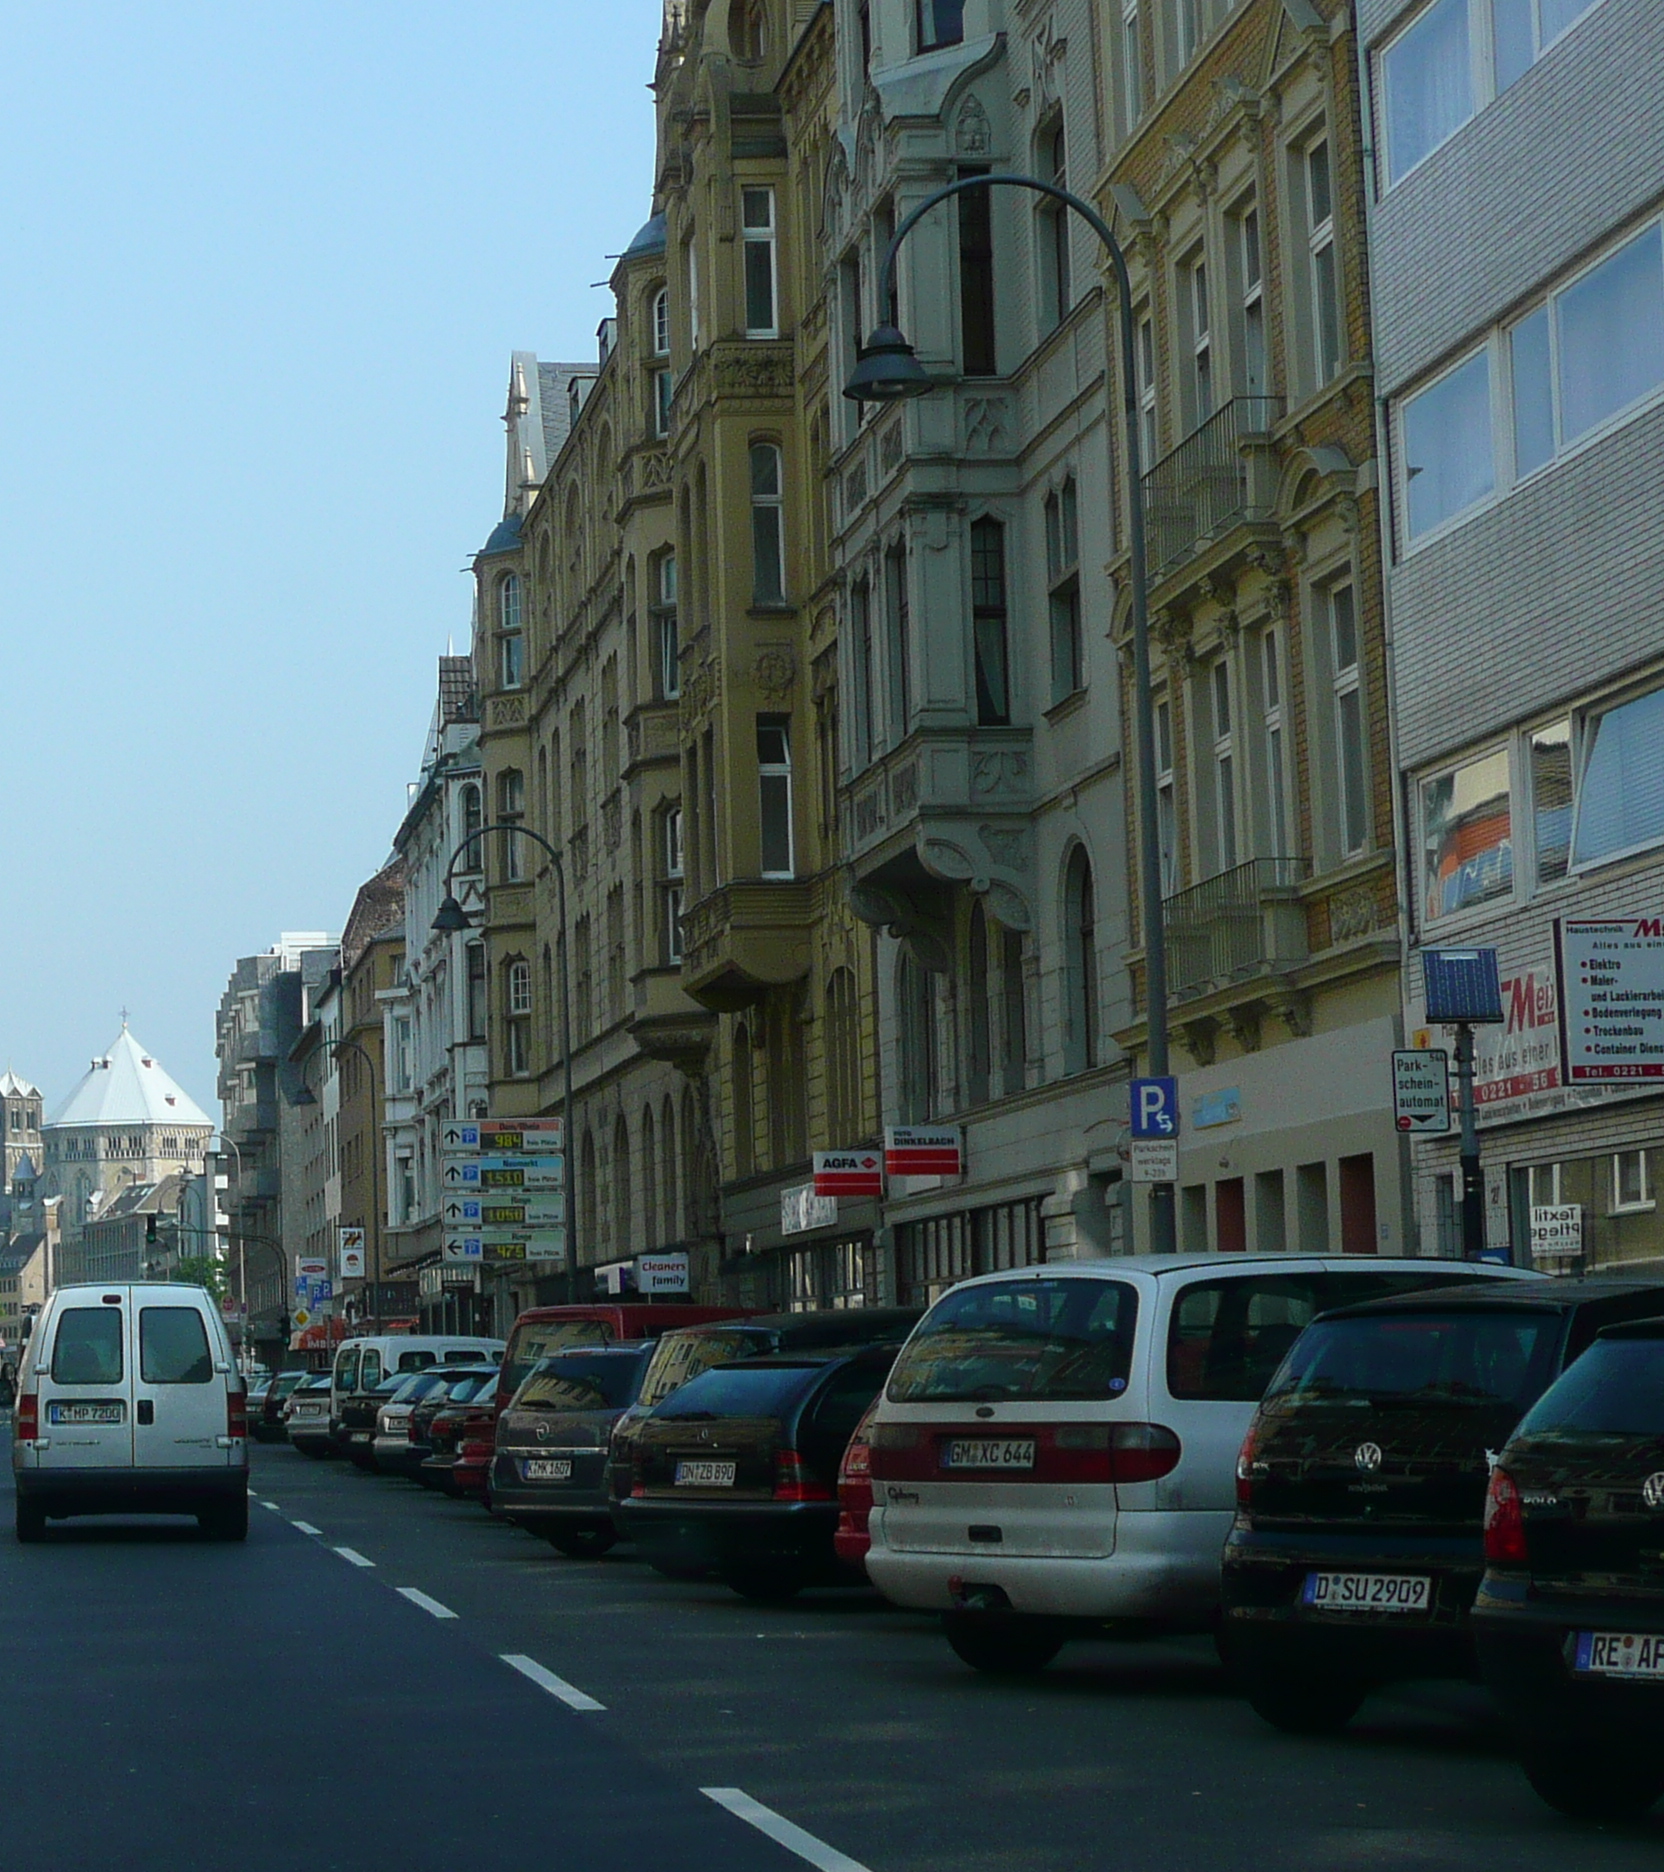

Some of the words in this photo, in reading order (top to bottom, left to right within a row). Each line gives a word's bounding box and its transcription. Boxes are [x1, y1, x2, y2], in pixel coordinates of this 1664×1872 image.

[1566, 925, 1624, 934] Haustechnik
[1592, 941, 1619, 950] Alles
[1589, 958, 1621, 971] Elektro
[1590, 974, 1618, 987] Maler-
[1591, 990, 1607, 1002] und
[1592, 1006, 1663, 1020] Bodenverlegung
[1593, 1025, 1644, 1037] Trockenbau
[1594, 1042, 1637, 1055] Container
[1397, 1059, 1428, 1071] Park-
[1613, 1066, 1643, 1076] 0221
[1398, 1076, 1440, 1090] schein-
[1481, 1080, 1512, 1100] 0221
[1140, 1085, 1165, 1130] P
[1399, 1096, 1444, 1108] automat
[893, 1137, 955, 1146] DINKELBACH
[822, 1158, 858, 1169] AGFA
[642, 1261, 686, 1272] Cleaners
[652, 1275, 686, 1288] family
[950, 1442, 972, 1463] GM
[979, 1442, 999, 1463] XC
[1003, 1441, 1032, 1463] 644
[1341, 1577, 1369, 1601] SU
[1371, 1578, 1425, 1604] 2909
[1592, 1636, 1621, 1667] RE
